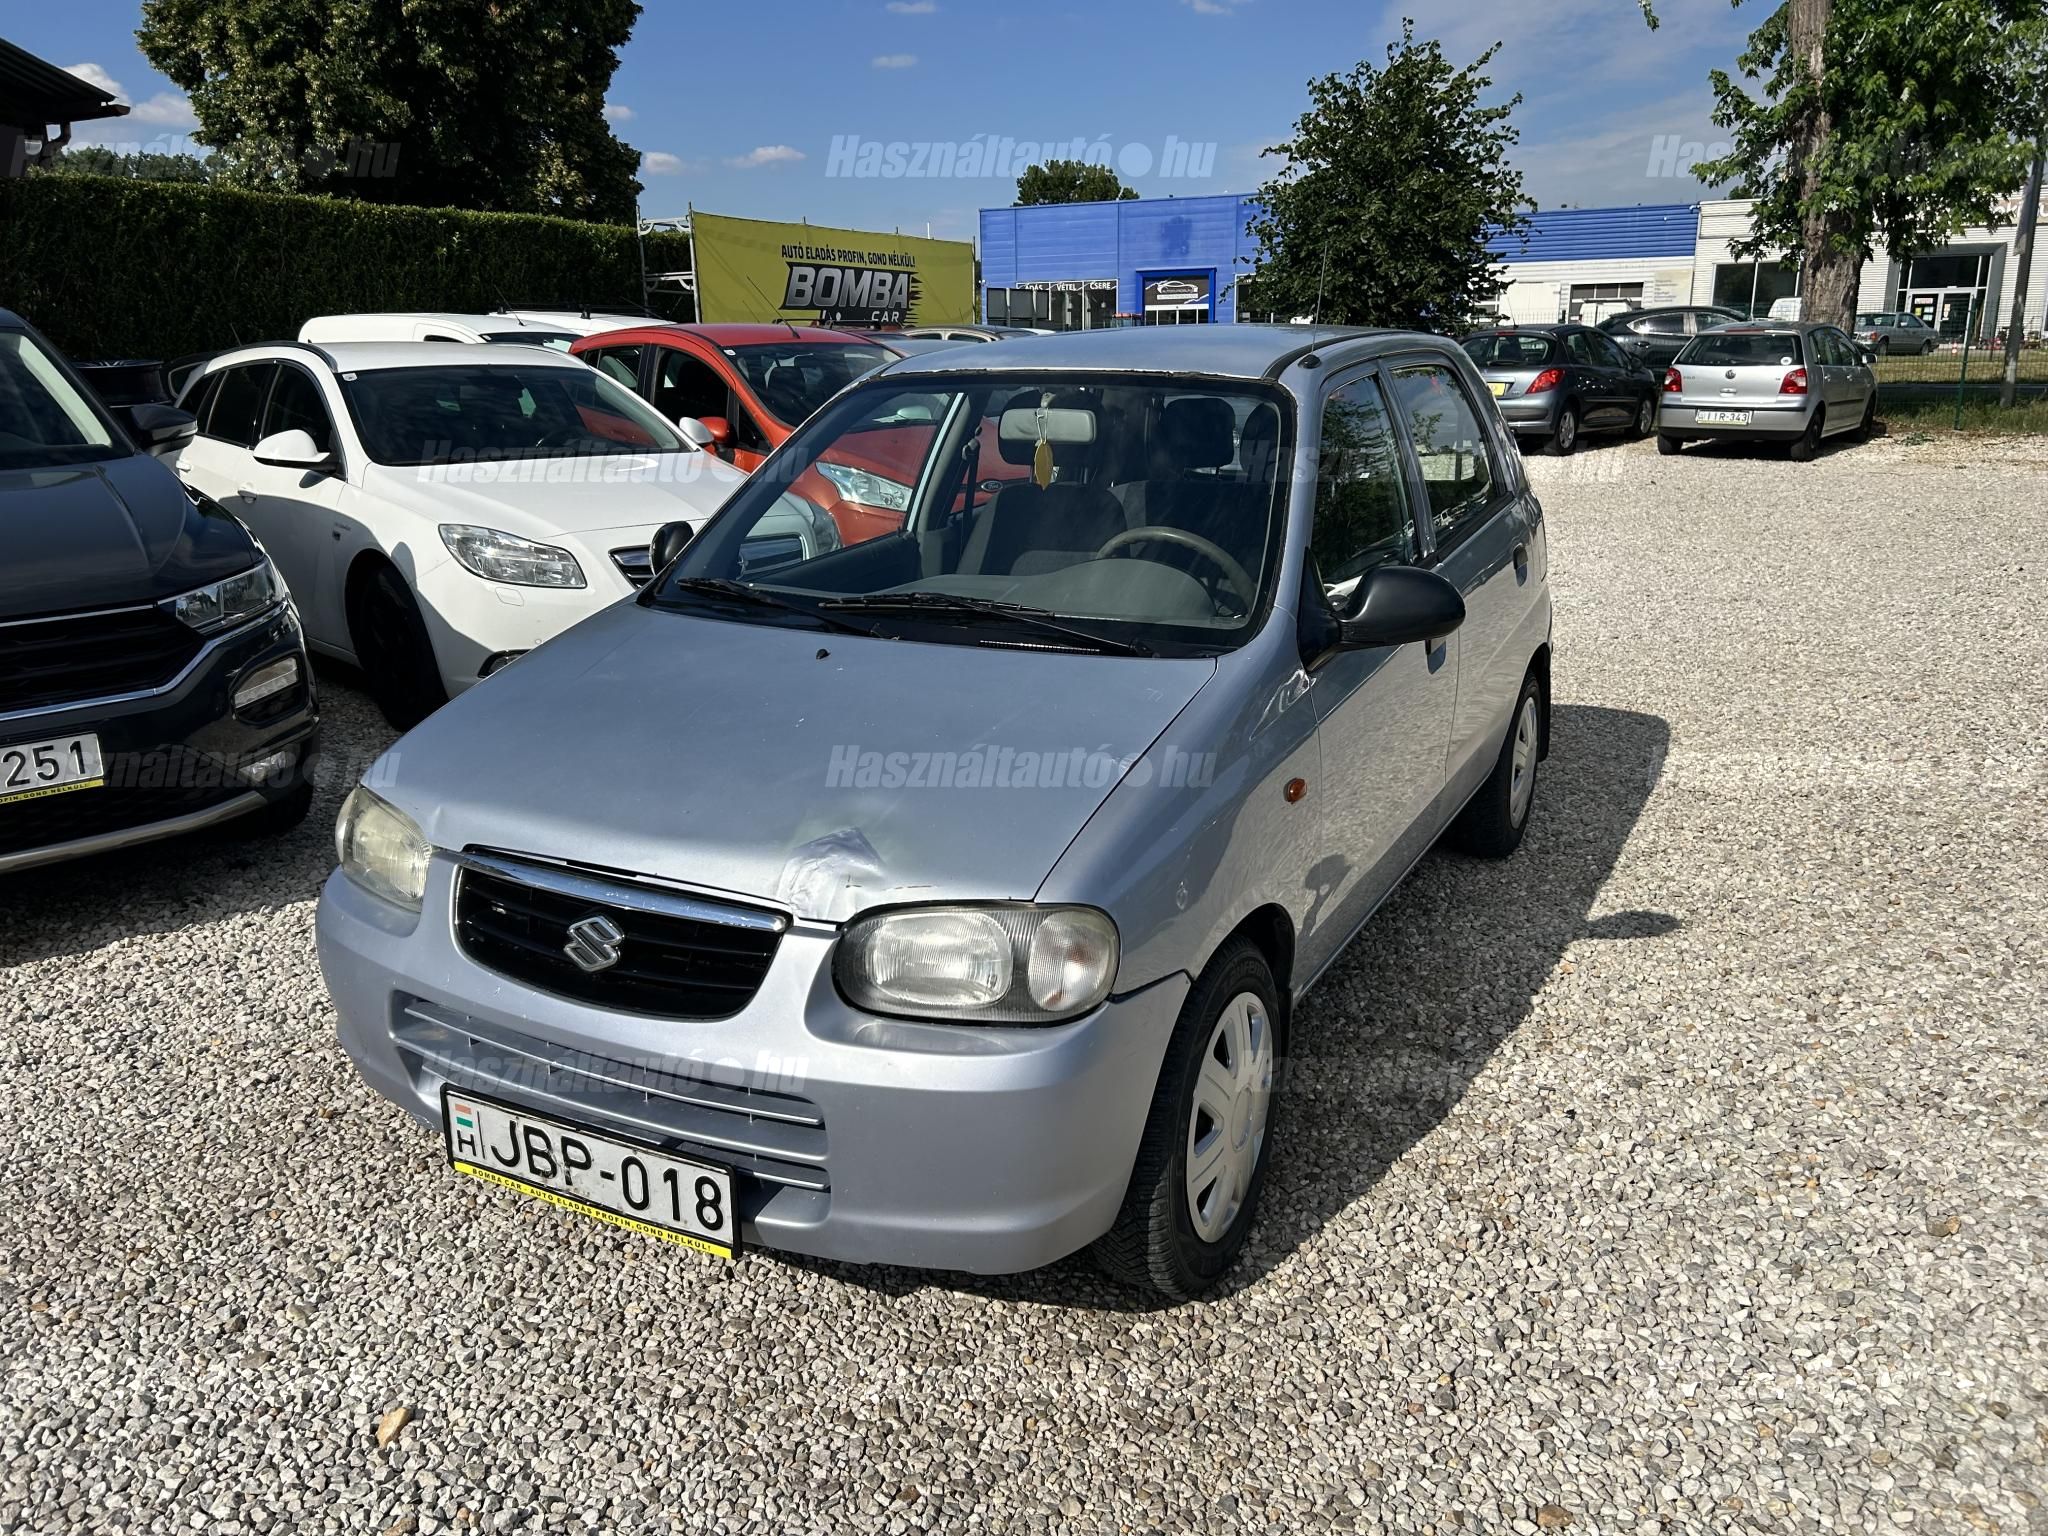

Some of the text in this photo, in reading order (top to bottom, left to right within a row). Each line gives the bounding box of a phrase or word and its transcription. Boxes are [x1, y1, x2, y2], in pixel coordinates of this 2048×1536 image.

[781, 242, 916, 268] AUTÓ ELADÁS PROFIN, GOND NÉLKÜL!
[785, 266, 911, 309] BOMBA
[1056, 283, 1076, 291] VÉTEL
[1089, 282, 1111, 290] CSERE
[871, 311, 900, 323] CAR
[472, 1168, 502, 1183] BOMBA
[504, 1179, 523, 1190] CAR
[490, 1120, 724, 1231] JBP-018
